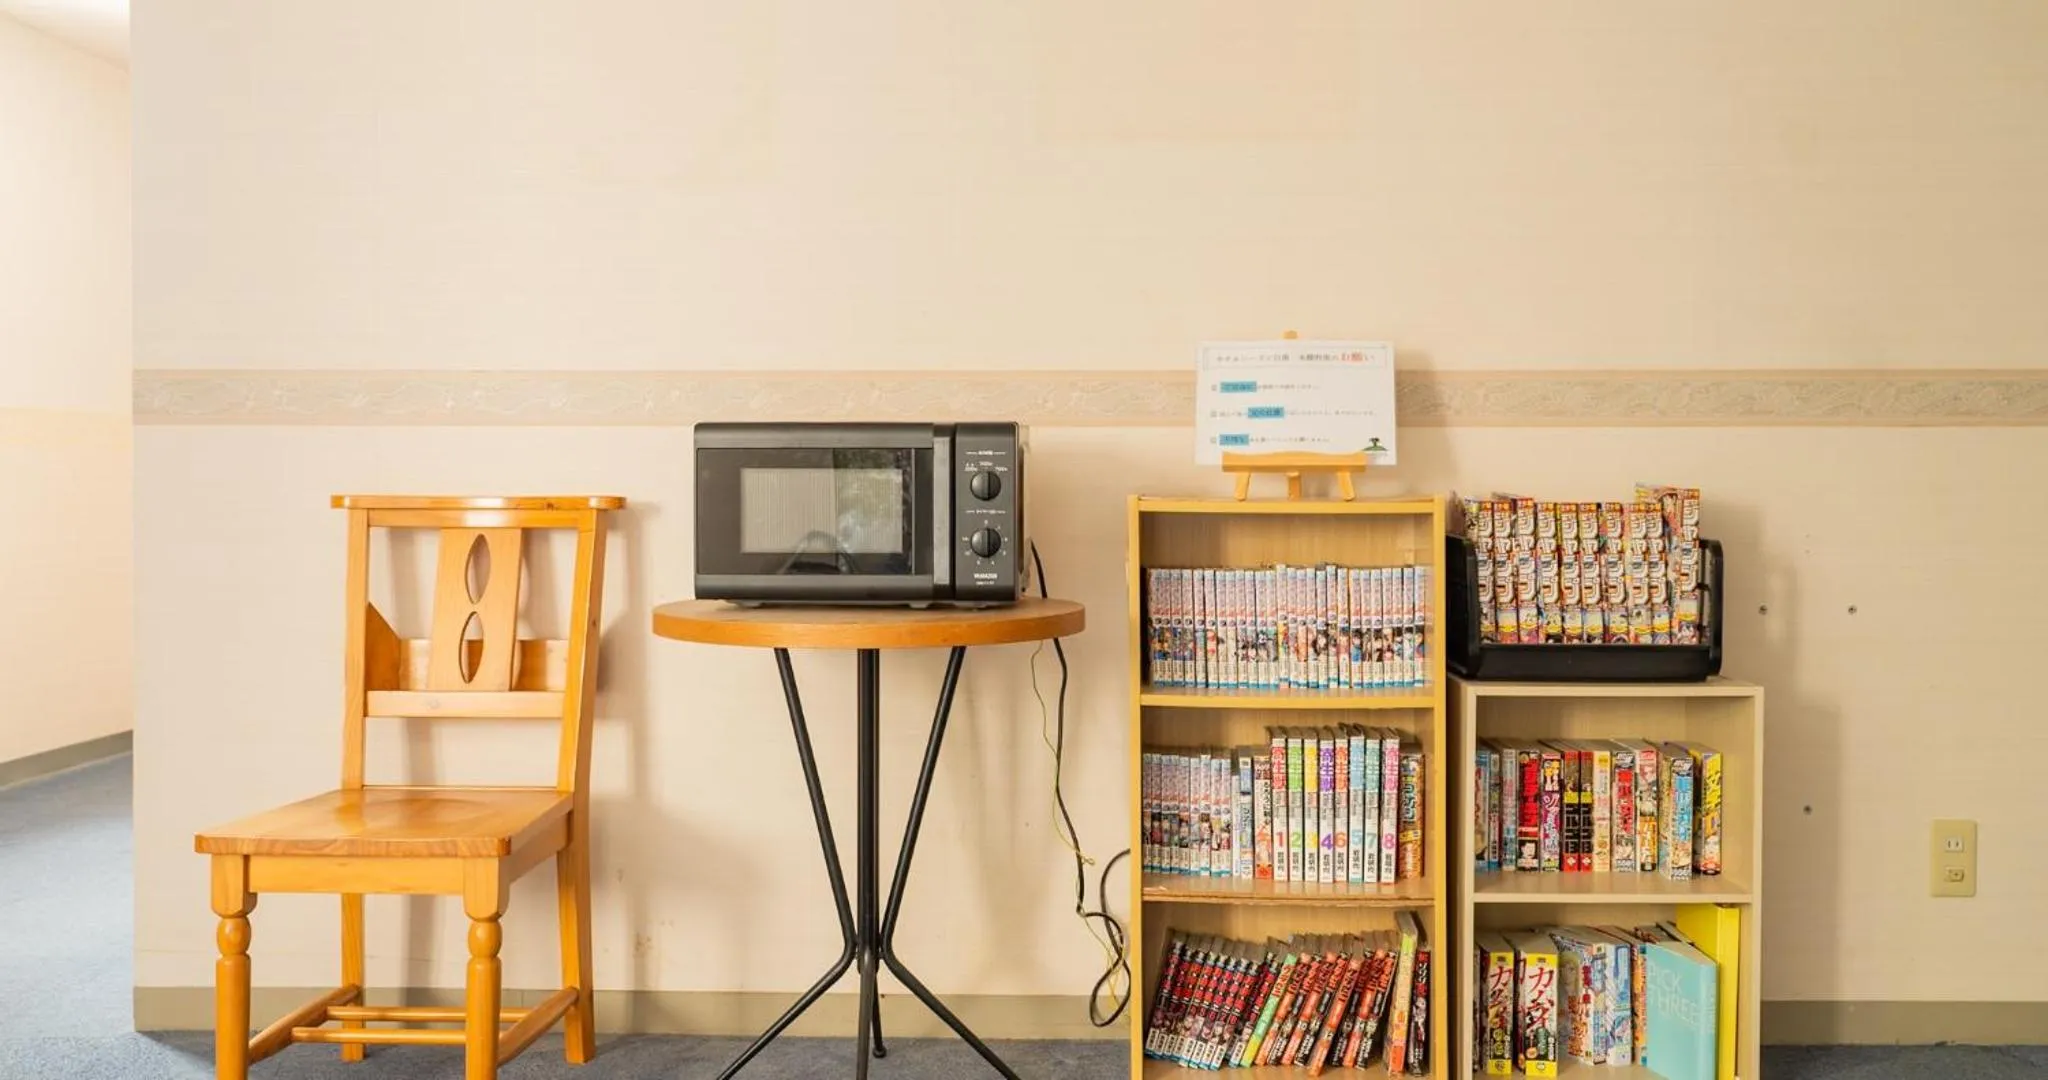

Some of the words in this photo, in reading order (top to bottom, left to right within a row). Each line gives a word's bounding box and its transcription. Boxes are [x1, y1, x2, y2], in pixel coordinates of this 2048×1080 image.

[1276, 832, 1284, 847] 1
[1291, 832, 1301, 848] 2
[1321, 833, 1333, 850] 4
[1334, 832, 1346, 848] 6
[1367, 833, 1377, 848] 7
[1383, 833, 1395, 849] 8
[1647, 963, 1682, 994] PICK
